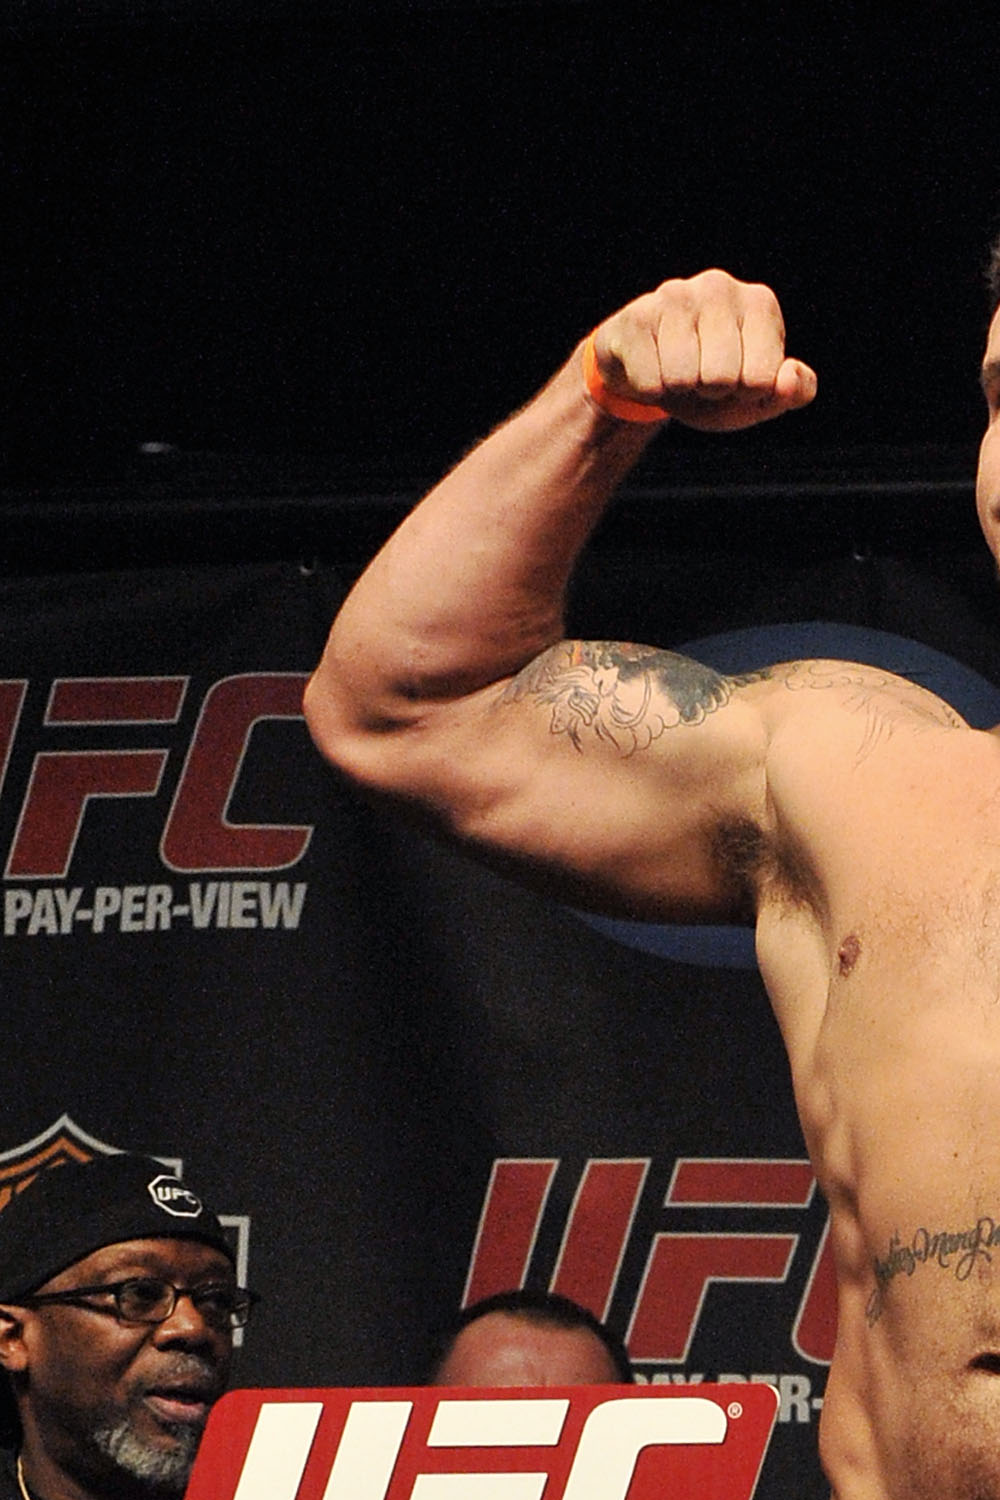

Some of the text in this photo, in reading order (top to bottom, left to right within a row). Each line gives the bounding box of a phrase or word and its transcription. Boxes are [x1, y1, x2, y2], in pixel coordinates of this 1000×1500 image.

[0, 672, 314, 880] FC
[4, 882, 307, 935] PAY-PER-VIEW
[157, 1187, 197, 1205] UFC
